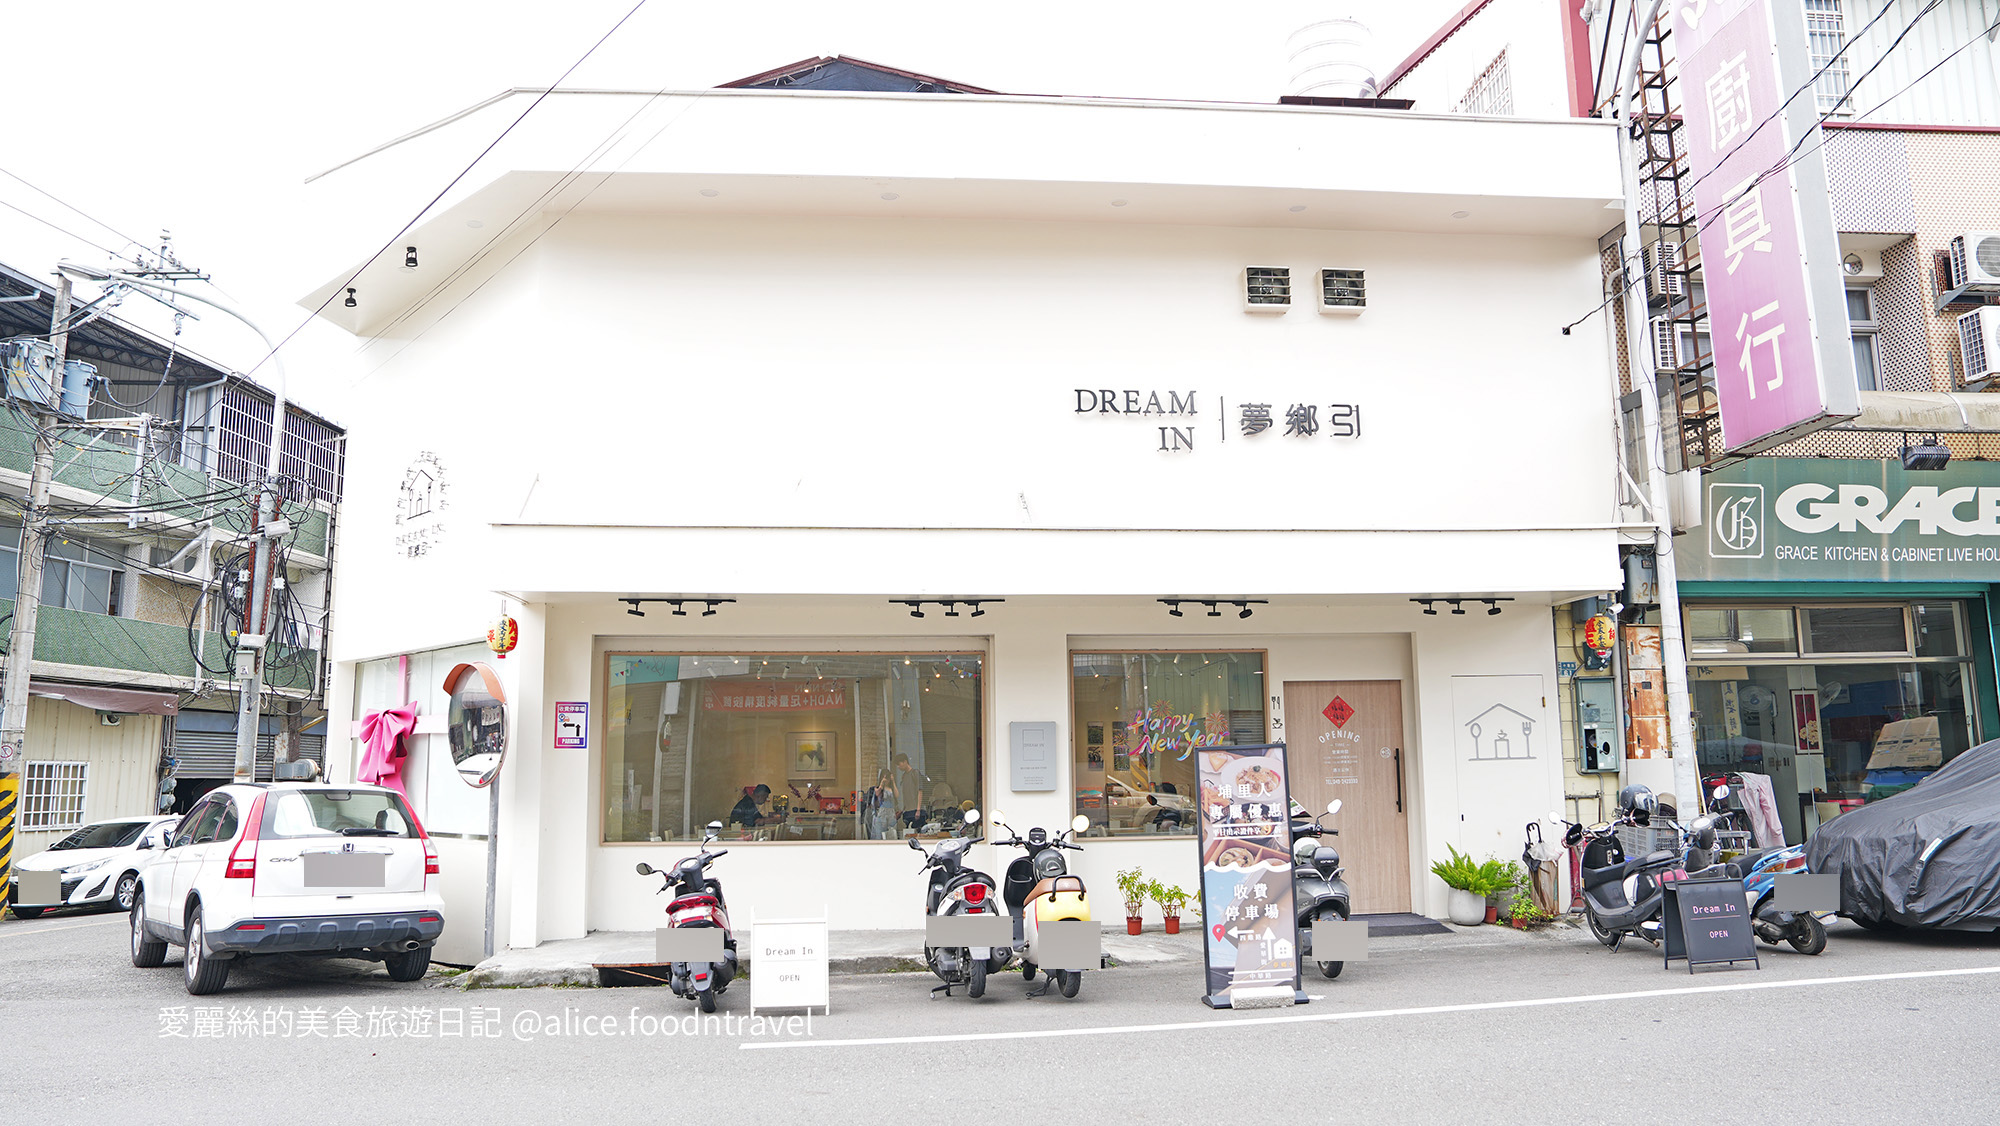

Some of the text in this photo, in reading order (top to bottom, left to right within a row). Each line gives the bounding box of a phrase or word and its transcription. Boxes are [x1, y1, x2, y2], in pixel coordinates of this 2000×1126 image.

[1704, 49, 1786, 400] 廚具行
[1074, 389, 1198, 415] DREAM
[1237, 402, 1362, 438] 夢鄉引
[1158, 426, 1195, 451] IN
[1775, 483, 2000, 536] GRACE
[1775, 546, 1818, 560] GRACE
[1824, 546, 1878, 561] KITCHEN
[1880, 548, 1889, 561] &
[1892, 548, 1944, 561] CABINET
[1947, 548, 1973, 561] LIVE
[1127, 707, 1198, 734] Happy
[1128, 729, 1231, 761] New Year
[1318, 730, 1361, 744] OPENING
[1218, 782, 1272, 799] 埔里人
[1209, 803, 1283, 820] 專屬優惠
[1233, 883, 1268, 900] 收費
[1225, 903, 1279, 921] 停車場
[1692, 903, 1736, 914] Dream In
[1709, 930, 1729, 939] OPEN
[765, 946, 814, 956] Dream In
[779, 974, 801, 982] OPEN
